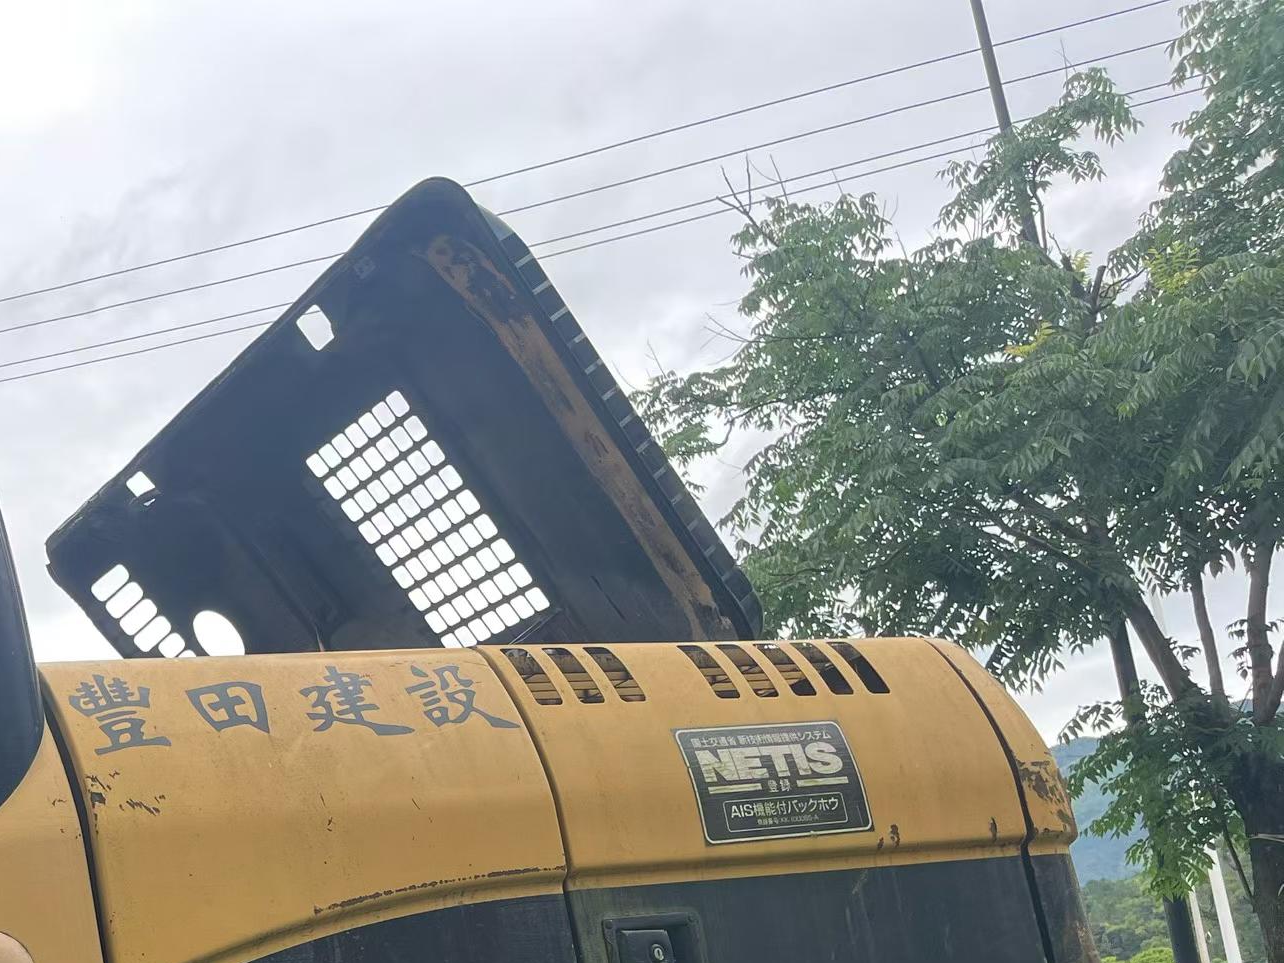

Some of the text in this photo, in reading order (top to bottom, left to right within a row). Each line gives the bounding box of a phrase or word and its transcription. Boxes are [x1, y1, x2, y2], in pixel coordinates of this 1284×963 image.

[694, 741, 844, 783] NETIS
[730, 796, 840, 819] AIS機能付バックホウ
